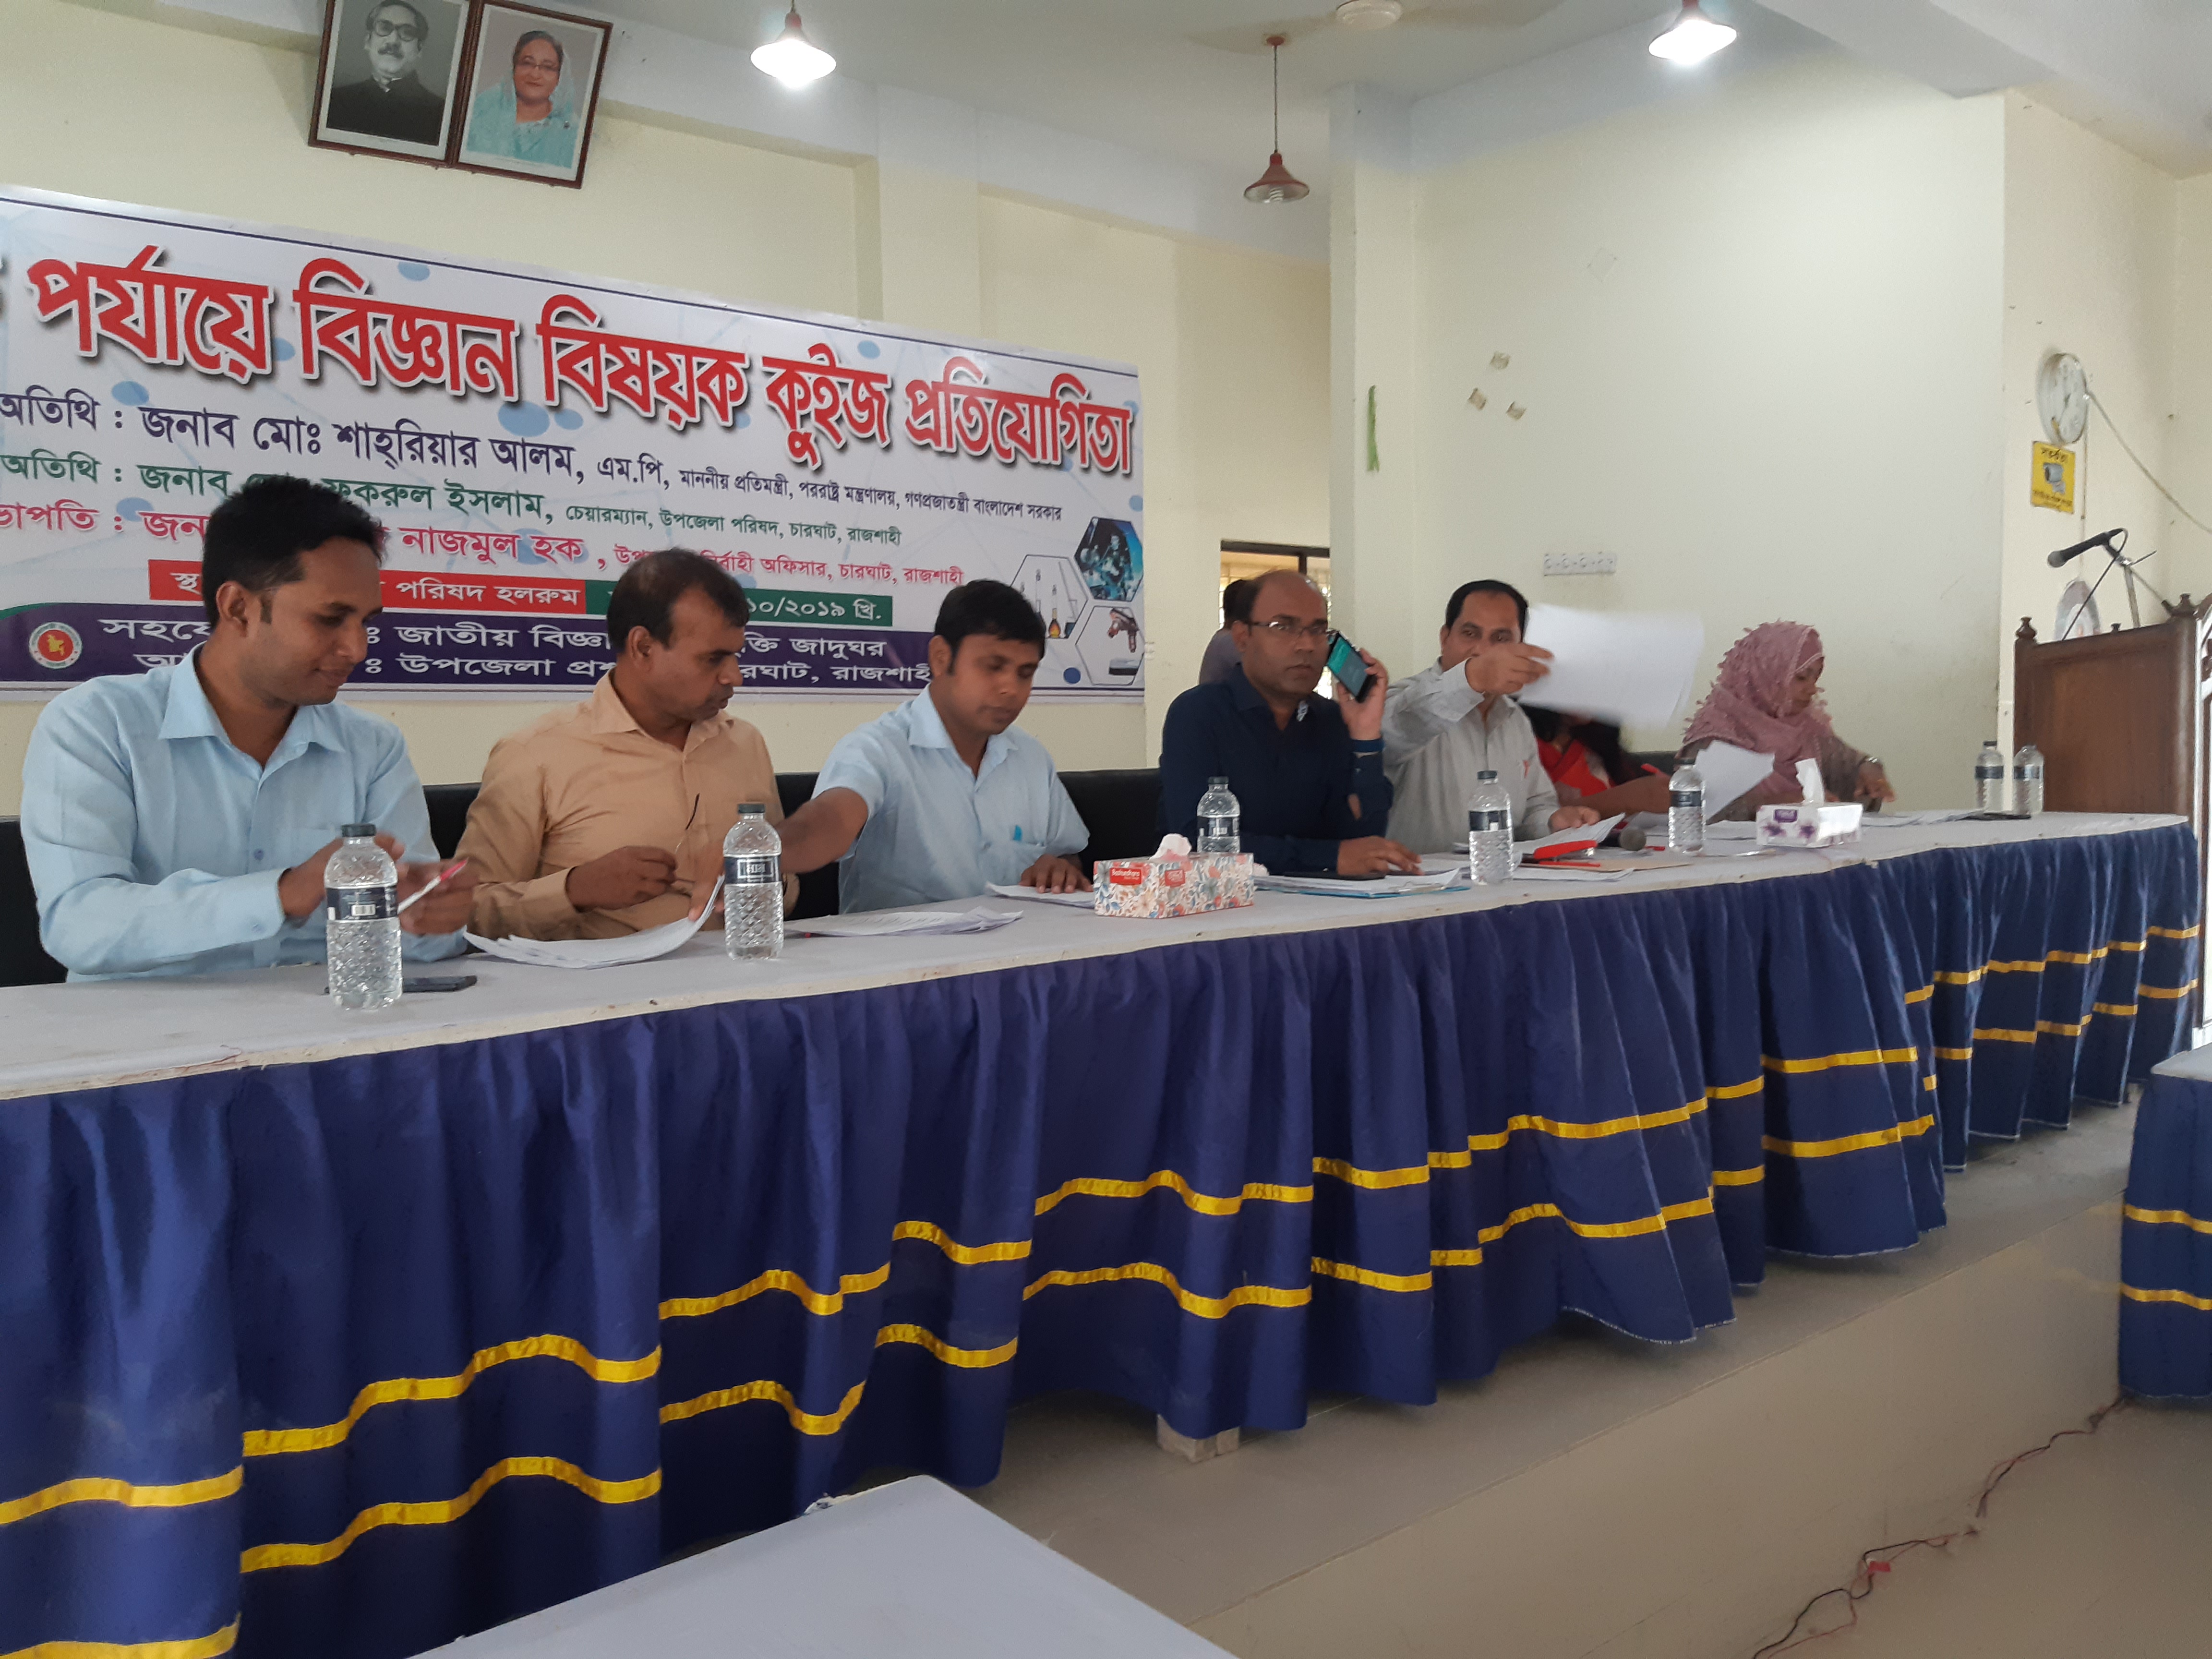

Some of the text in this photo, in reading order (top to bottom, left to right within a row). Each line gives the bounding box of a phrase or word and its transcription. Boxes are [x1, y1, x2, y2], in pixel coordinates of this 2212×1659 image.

[27, 245, 1130, 471] পর্যায়ে বিজ্ঞান বিষয়ক কুইজ প্রতিযোগিতা
[0, 385, 101, 431] অতিথি
[137, 407, 239, 448] জনাব
[253, 416, 321, 455] মোঃ
[489, 437, 584, 484] আলম,
[679, 466, 729, 490] মাননীয়
[974, 498, 1023, 517] বাংলাদেশ
[1027, 504, 1062, 521] সরকার
[0, 448, 102, 483] অতিথি
[136, 464, 231, 496] জনাব
[443, 478, 553, 525] ইসলাম,
[566, 505, 653, 529] চেয়ারম্যান,
[659, 507, 725, 531] উপজেলা
[731, 514, 784, 540] পরিষদ,
[788, 521, 842, 544] চারঘাট,
[846, 526, 902, 545] রাজশাহী
[529, 535, 584, 564] হক
[759, 554, 833, 581] অফিসার,
[838, 562, 897, 585] চারঘাট,
[903, 566, 964, 585] রাজশাহী
[396, 577, 486, 602] পরিষদ
[493, 586, 581, 605] হলরুম
[393, 621, 519, 648] জাতীয়
[528, 625, 612, 650] বিজ্ঞা
[789, 637, 887, 660] জাদুঘর
[395, 653, 556, 675] উপজেলা
